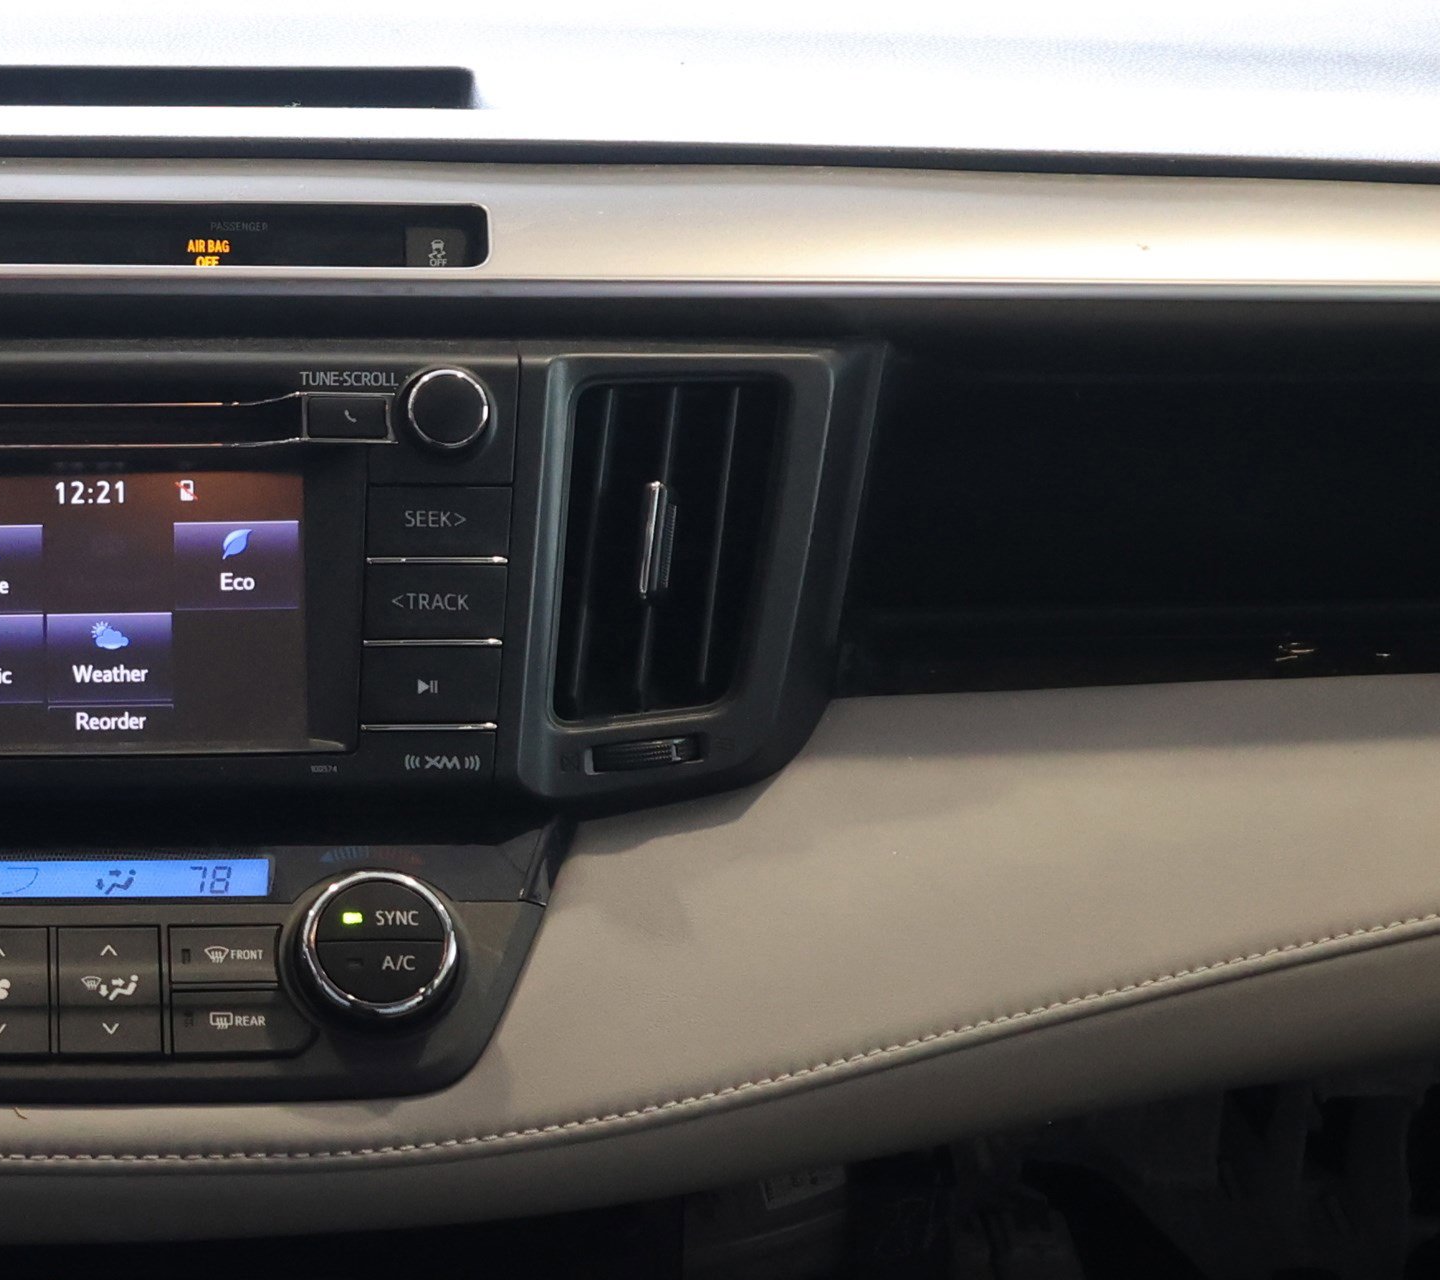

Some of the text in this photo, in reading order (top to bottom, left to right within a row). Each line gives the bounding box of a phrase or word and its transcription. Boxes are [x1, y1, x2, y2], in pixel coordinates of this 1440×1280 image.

[210, 221, 269, 232] PASSENGER
[187, 239, 230, 253] AIR BAG
[195, 256, 220, 267] OFF
[429, 258, 447, 267] OFF
[55, 480, 125, 505] 12:21
[220, 572, 255, 591] Eco
[72, 664, 148, 683] Weather
[75, 712, 146, 731] Reorder
[190, 866, 232, 895] 78
[375, 910, 419, 926] SYNC
[230, 949, 263, 960] FRONT
[382, 955, 416, 971] A/C
[235, 1015, 266, 1027] REAR
